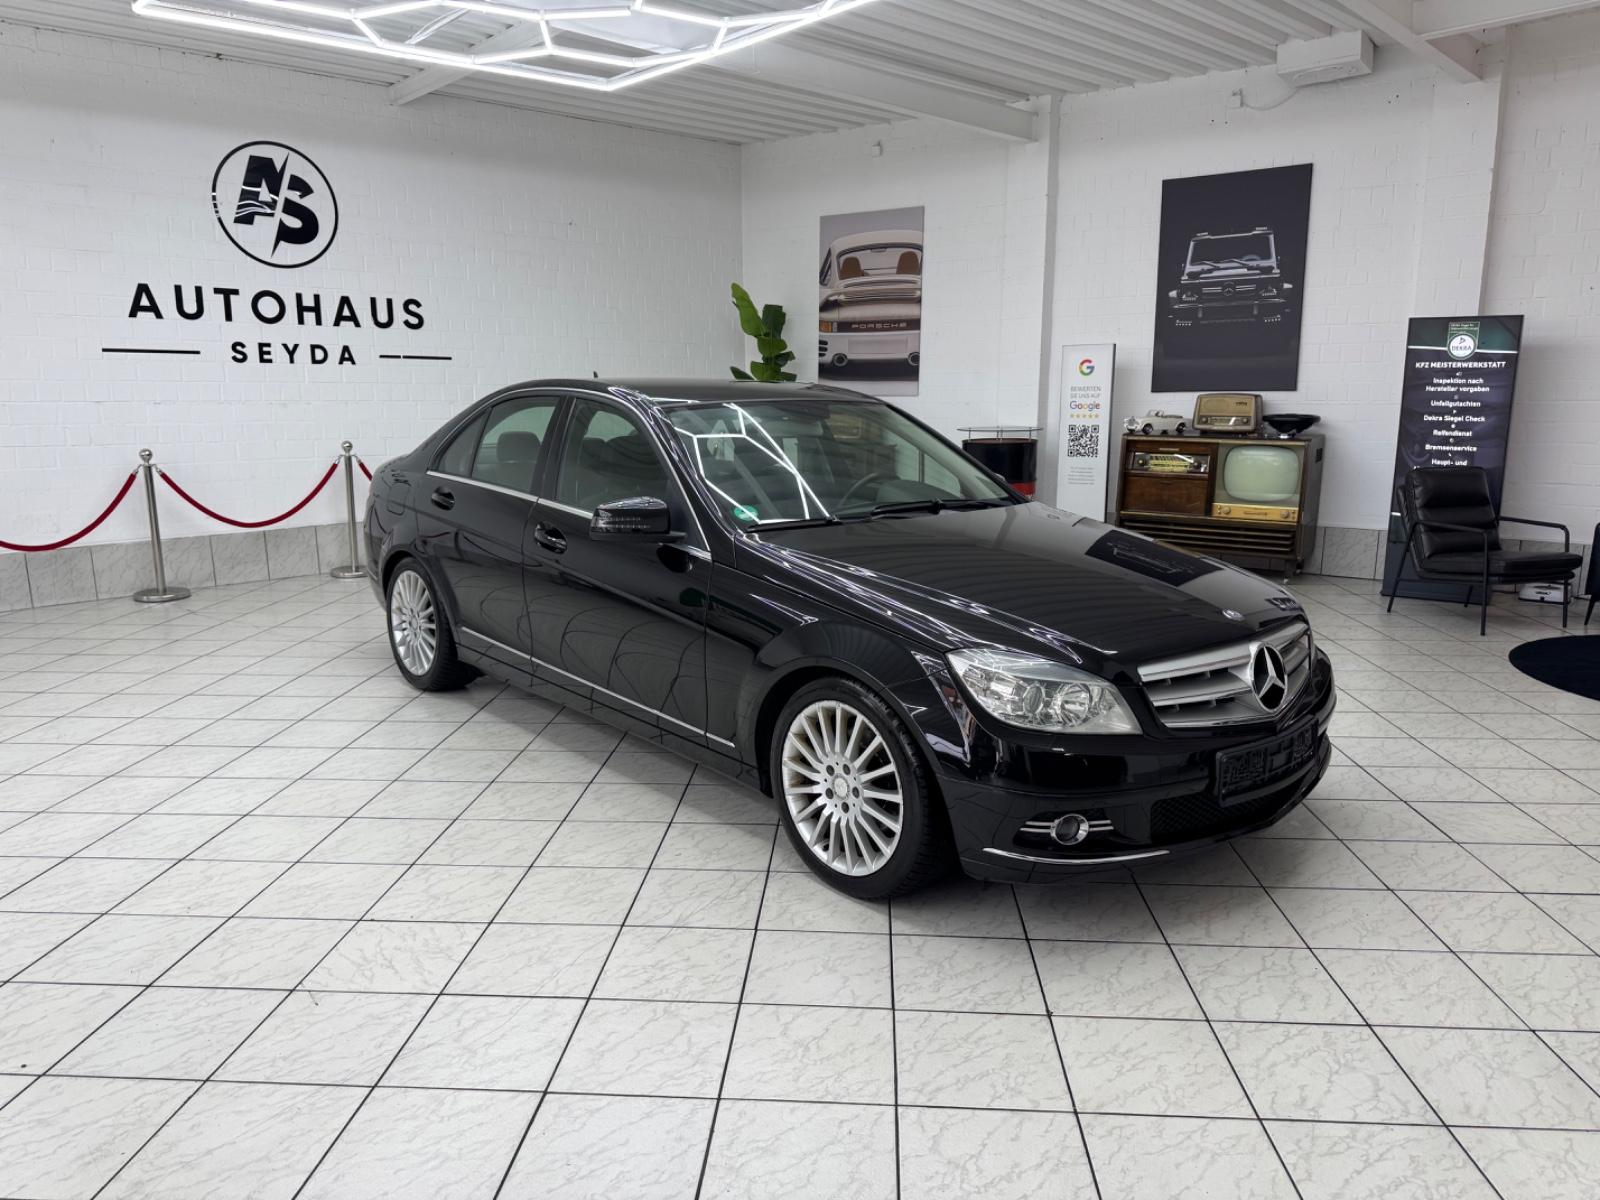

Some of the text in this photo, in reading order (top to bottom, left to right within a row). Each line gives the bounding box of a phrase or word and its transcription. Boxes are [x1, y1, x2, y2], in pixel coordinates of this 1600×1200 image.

[128, 282, 425, 330] AUTOHAUS
[231, 341, 357, 366] SEYDA
[1079, 359, 1095, 376] G
[1415, 361, 1507, 369] KFZ MEISTERWERKSTATT
[1433, 377, 1467, 386] Inspektion
[1070, 400, 1101, 412] Google
[1430, 400, 1481, 408] Unfallgutachten
[1443, 415, 1464, 423] Siegel
[1432, 429, 1473, 437] Reifendienst
[1425, 444, 1477, 452] Bremsenservice
[1431, 458, 1454, 466] Haupt-
